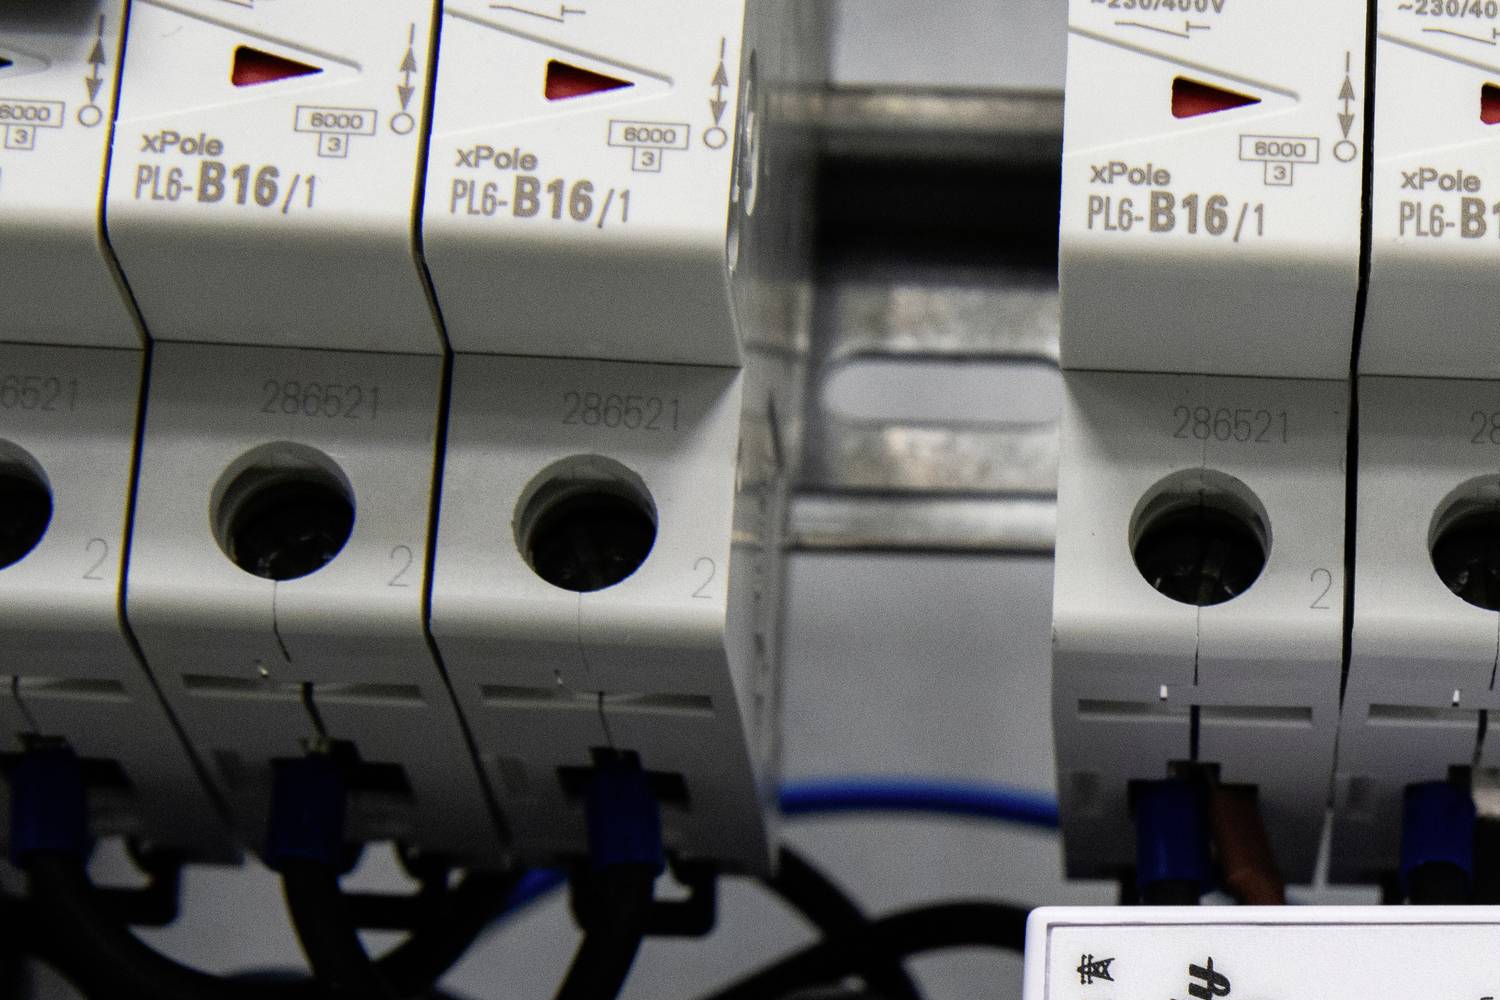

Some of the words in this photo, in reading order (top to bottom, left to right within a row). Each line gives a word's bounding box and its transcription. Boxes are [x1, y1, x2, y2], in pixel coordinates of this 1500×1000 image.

[310, 112, 364, 130] 6000
[14, 129, 28, 144] 3
[140, 130, 225, 157] xPole
[327, 137, 341, 152] 3
[623, 127, 677, 145] 6000
[1254, 141, 1307, 158] 6000
[455, 144, 538, 172] xPole
[641, 151, 655, 166] 3
[1090, 161, 1171, 186] xPole
[1273, 165, 1286, 181] 3
[1401, 167, 1482, 193] xPole
[135, 161, 316, 214] PL6-B16/1
[450, 175, 631, 229] PL6-B16/1
[1087, 190, 1265, 243] PL6-B16/1
[260, 380, 382, 419] 286521
[562, 391, 682, 432] 286521
[1172, 405, 1288, 444] 286521
[82, 538, 109, 580] 2
[387, 544, 413, 587] 2
[691, 556, 716, 599] 2
[1309, 567, 1332, 610] 2
